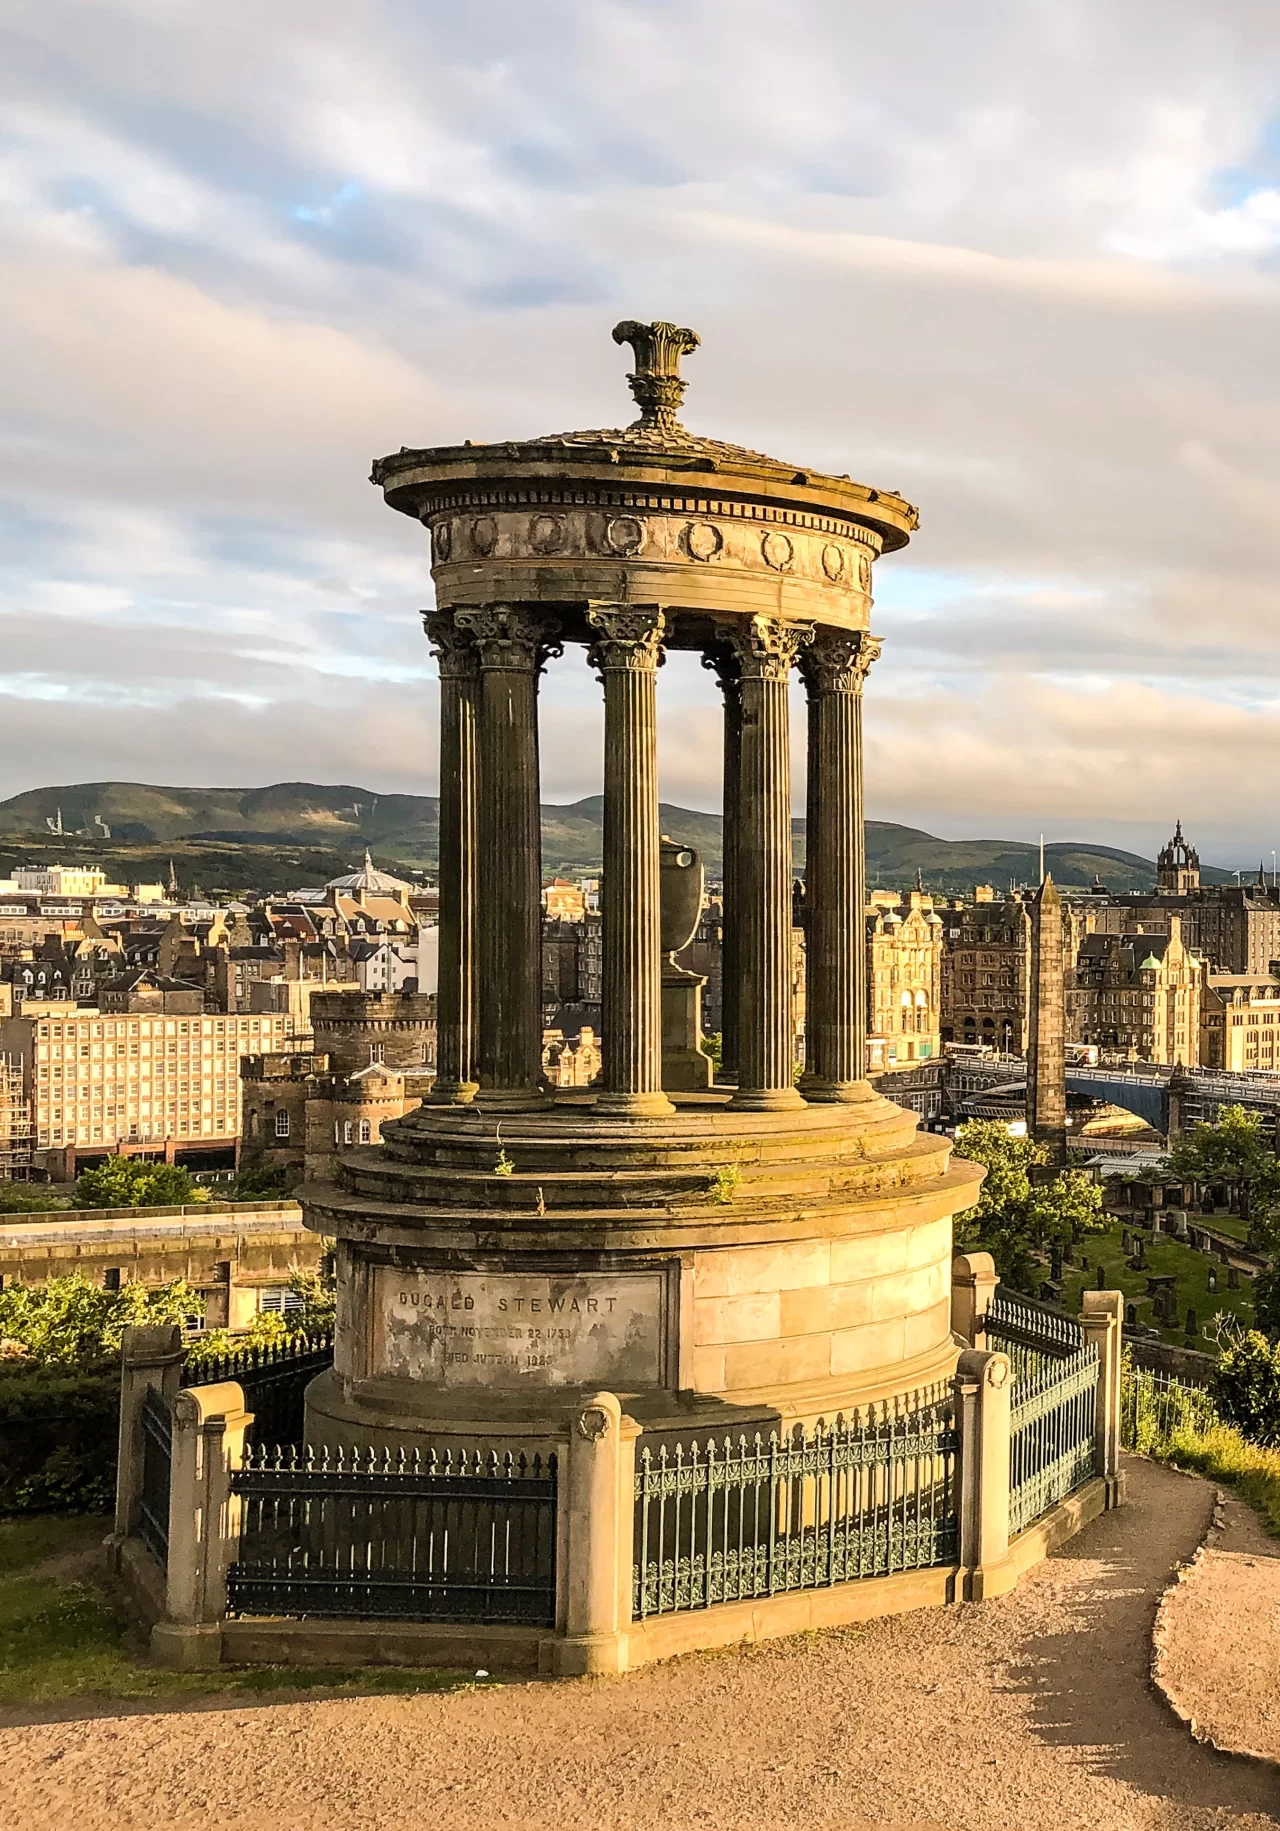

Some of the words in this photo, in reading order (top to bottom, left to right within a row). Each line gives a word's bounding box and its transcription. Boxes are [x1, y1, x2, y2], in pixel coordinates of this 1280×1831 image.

[399, 1291, 475, 1310] DUGALD
[497, 1297, 617, 1313] STEWART
[527, 1328, 541, 1339] 22
[546, 1328, 571, 1339] 1753
